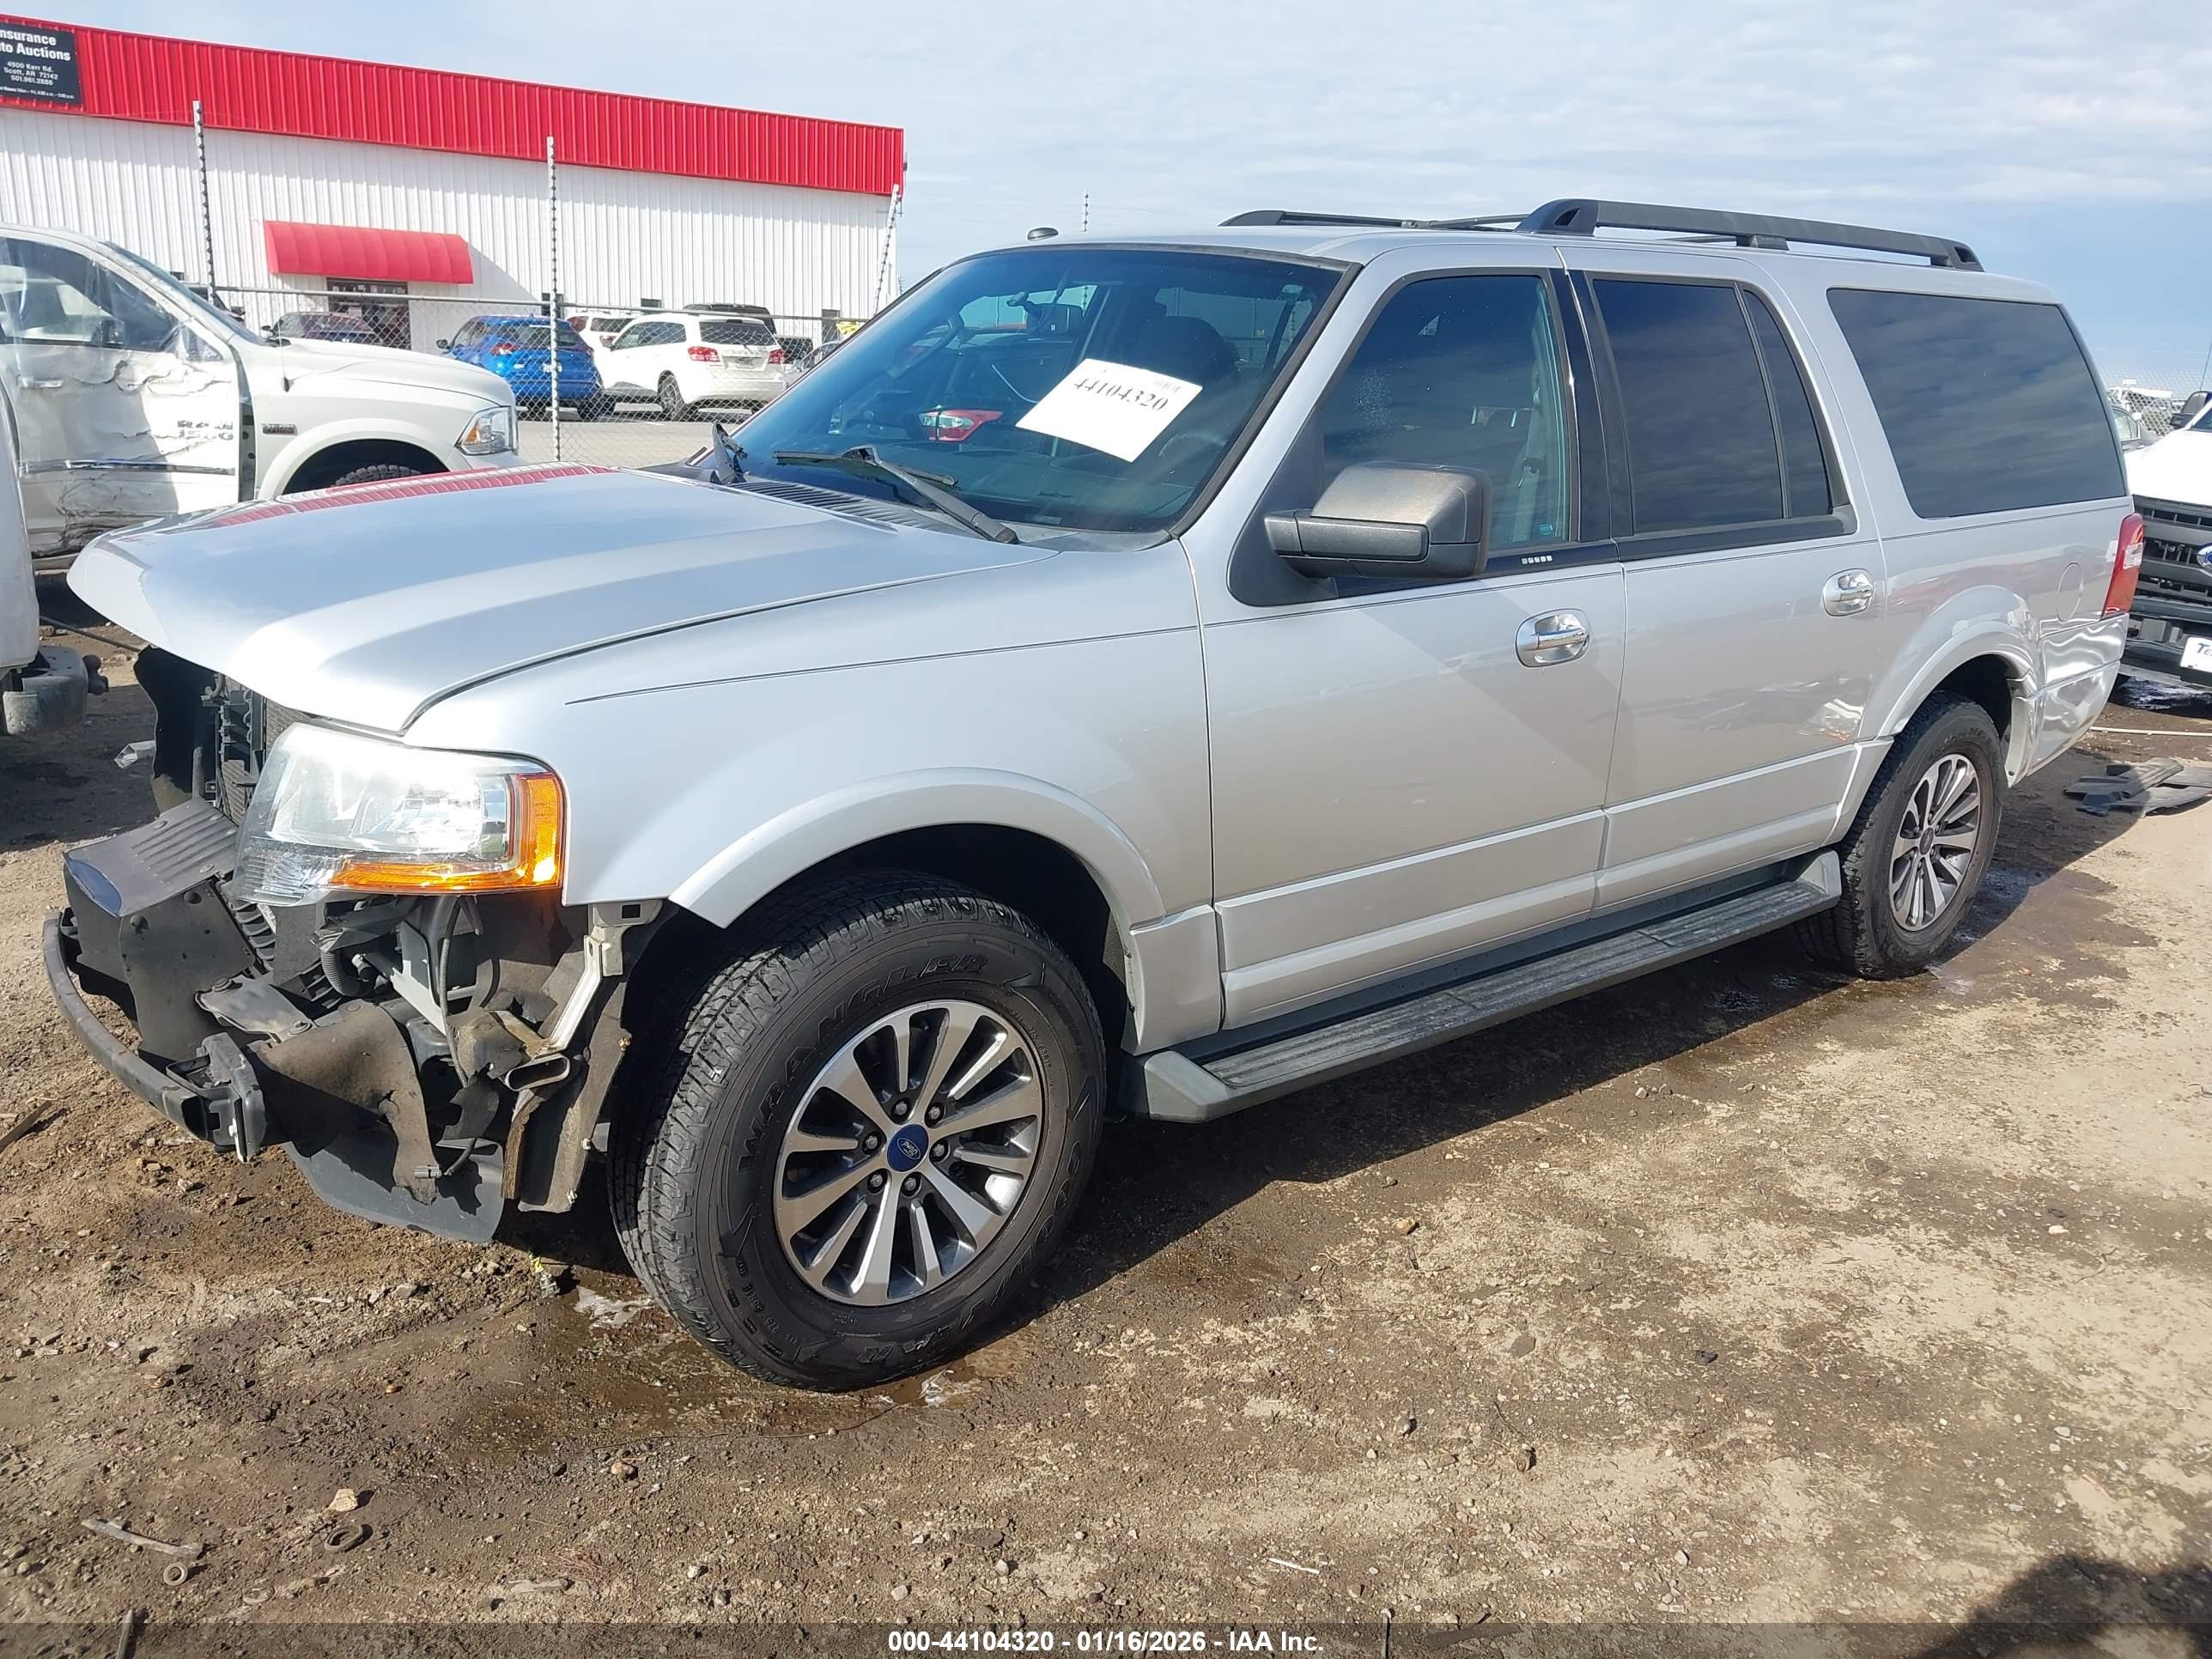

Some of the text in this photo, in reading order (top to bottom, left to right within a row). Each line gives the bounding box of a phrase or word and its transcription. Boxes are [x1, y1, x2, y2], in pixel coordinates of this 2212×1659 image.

[0, 29, 57, 46] nsurance
[0, 41, 70, 61] to Auctions
[1073, 378, 1169, 411] 44104320
